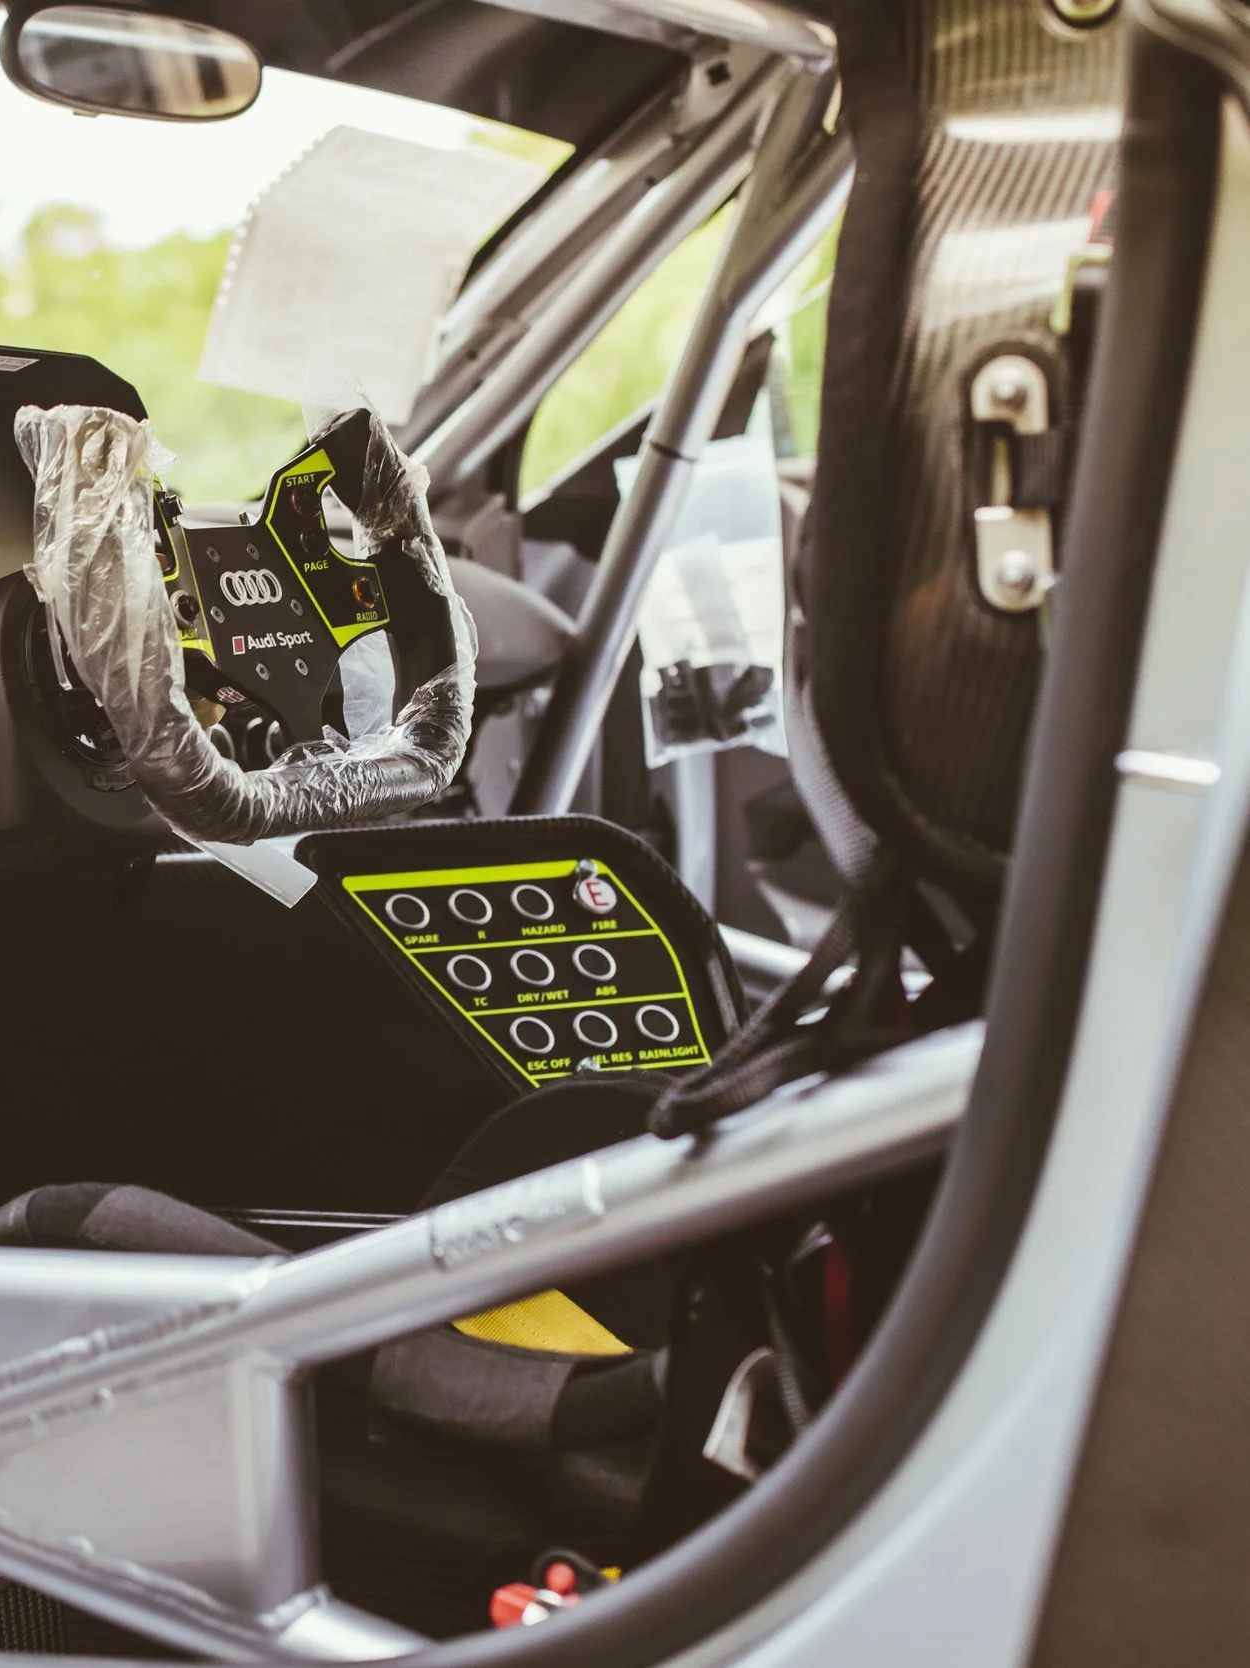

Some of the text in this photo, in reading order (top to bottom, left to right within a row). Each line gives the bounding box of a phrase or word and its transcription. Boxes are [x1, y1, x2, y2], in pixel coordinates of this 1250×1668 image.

[286, 474, 315, 487] START
[304, 560, 329, 572] PAGE
[356, 611, 378, 622] RADIO
[247, 631, 313, 650] Audi Sport
[585, 881, 609, 906] E
[521, 924, 566, 936] HAZARD
[592, 919, 617, 931] FIRE
[404, 934, 440, 945] SPARE
[477, 930, 486, 940] R
[517, 989, 569, 1003] DRY/WET
[596, 985, 617, 997] ABS
[473, 997, 488, 1007] TC
[611, 1051, 633, 1063] RES
[639, 1045, 699, 1060] RAINLIGHT
[527, 1058, 571, 1071] ESC OFF
